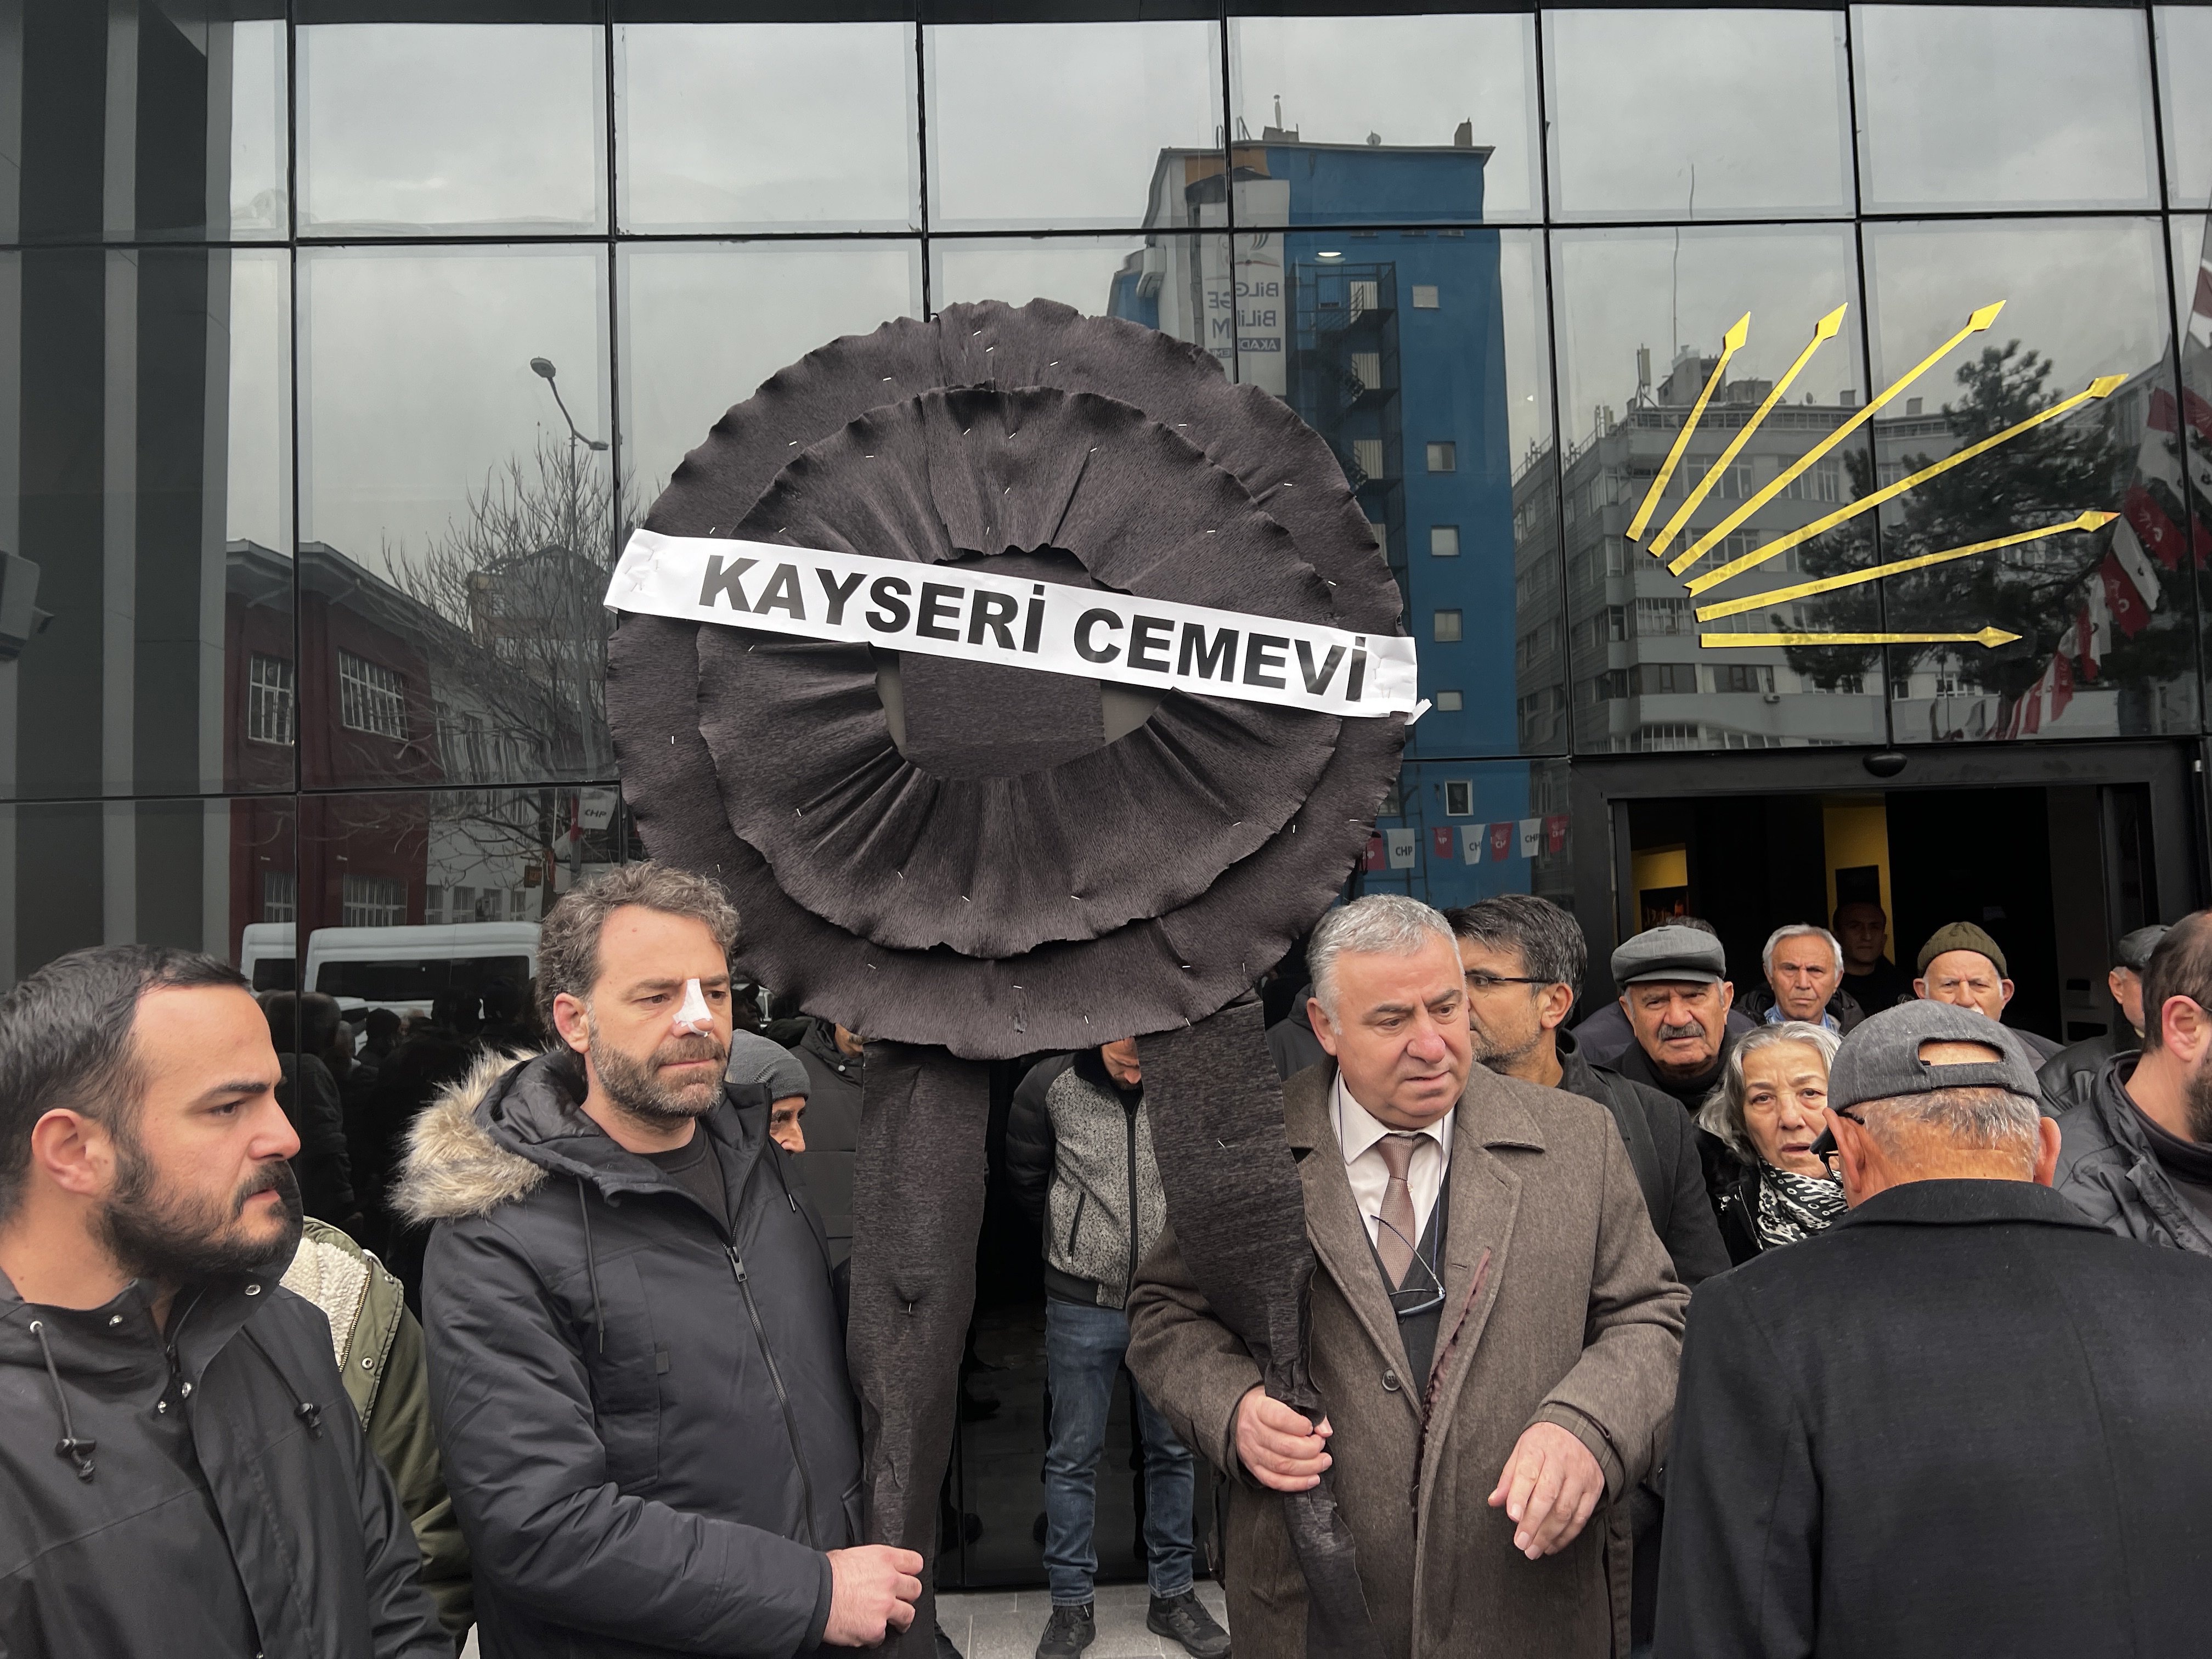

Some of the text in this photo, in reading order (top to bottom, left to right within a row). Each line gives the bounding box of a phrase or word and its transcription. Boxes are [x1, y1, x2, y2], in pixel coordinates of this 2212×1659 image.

[699, 555, 1367, 703] KAYSERİ CEMEVİ
[585, 809, 607, 817] CHP
[1395, 845, 1413, 856] CHP
[1469, 841, 1481, 851] CH
